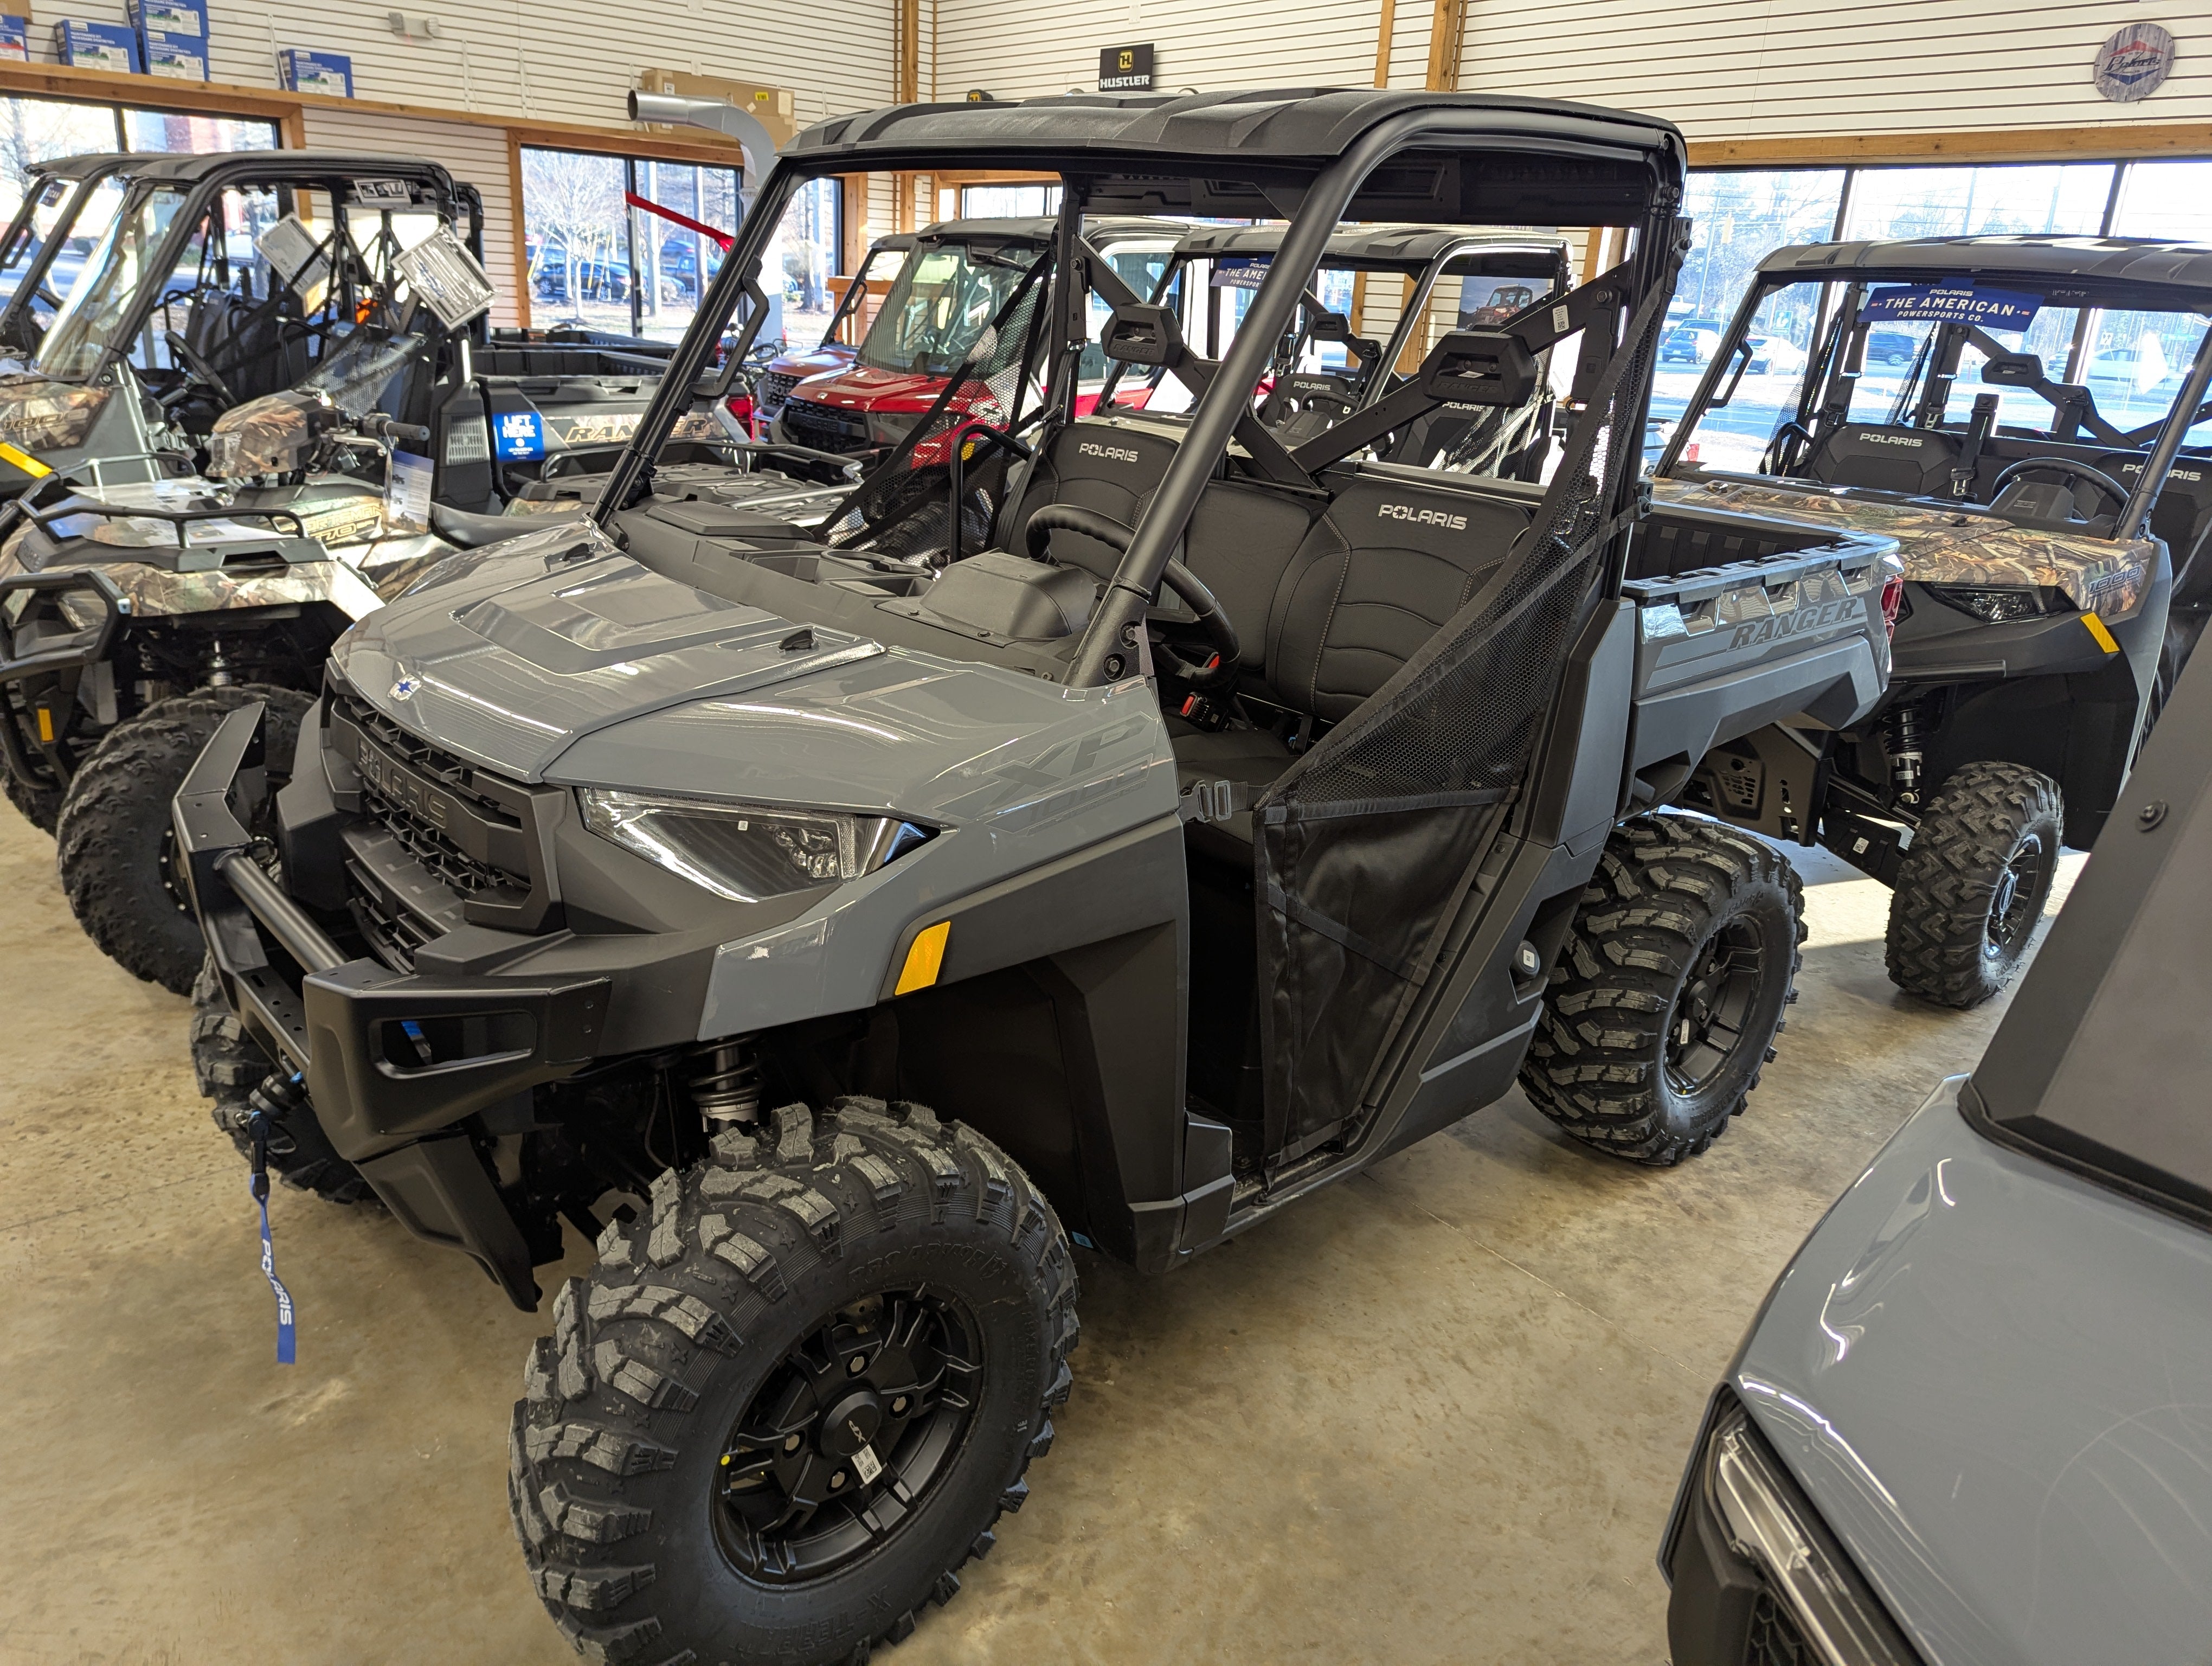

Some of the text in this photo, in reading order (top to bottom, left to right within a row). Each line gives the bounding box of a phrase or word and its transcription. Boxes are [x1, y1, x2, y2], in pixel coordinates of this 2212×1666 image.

[2103, 56, 2162, 72] Polaris
[1099, 75, 1150, 89] HUSTLER
[1225, 268, 1243, 277] THE
[1230, 279, 1262, 288] POWERSPOR
[1929, 289, 1973, 297] POLARIS
[1885, 297, 2016, 316] THE AMERICAN
[1896, 310, 1984, 323] POWERSPORTS CO.
[1293, 381, 1331, 391] POLARIS
[504, 414, 531, 427] LIFT
[502, 425, 536, 438] HERE
[1859, 433, 1923, 447] POLARIS
[1078, 443, 1139, 463] POLARIS
[2121, 464, 2202, 482] PORIS
[1378, 504, 1468, 530] POLARIS
[2089, 565, 2142, 595] 1000
[1728, 598, 1857, 650] RANGER
[358, 736, 448, 829] POLARIS
[261, 1239, 292, 1326] POLARIS
[848, 1420, 867, 1443] XP
